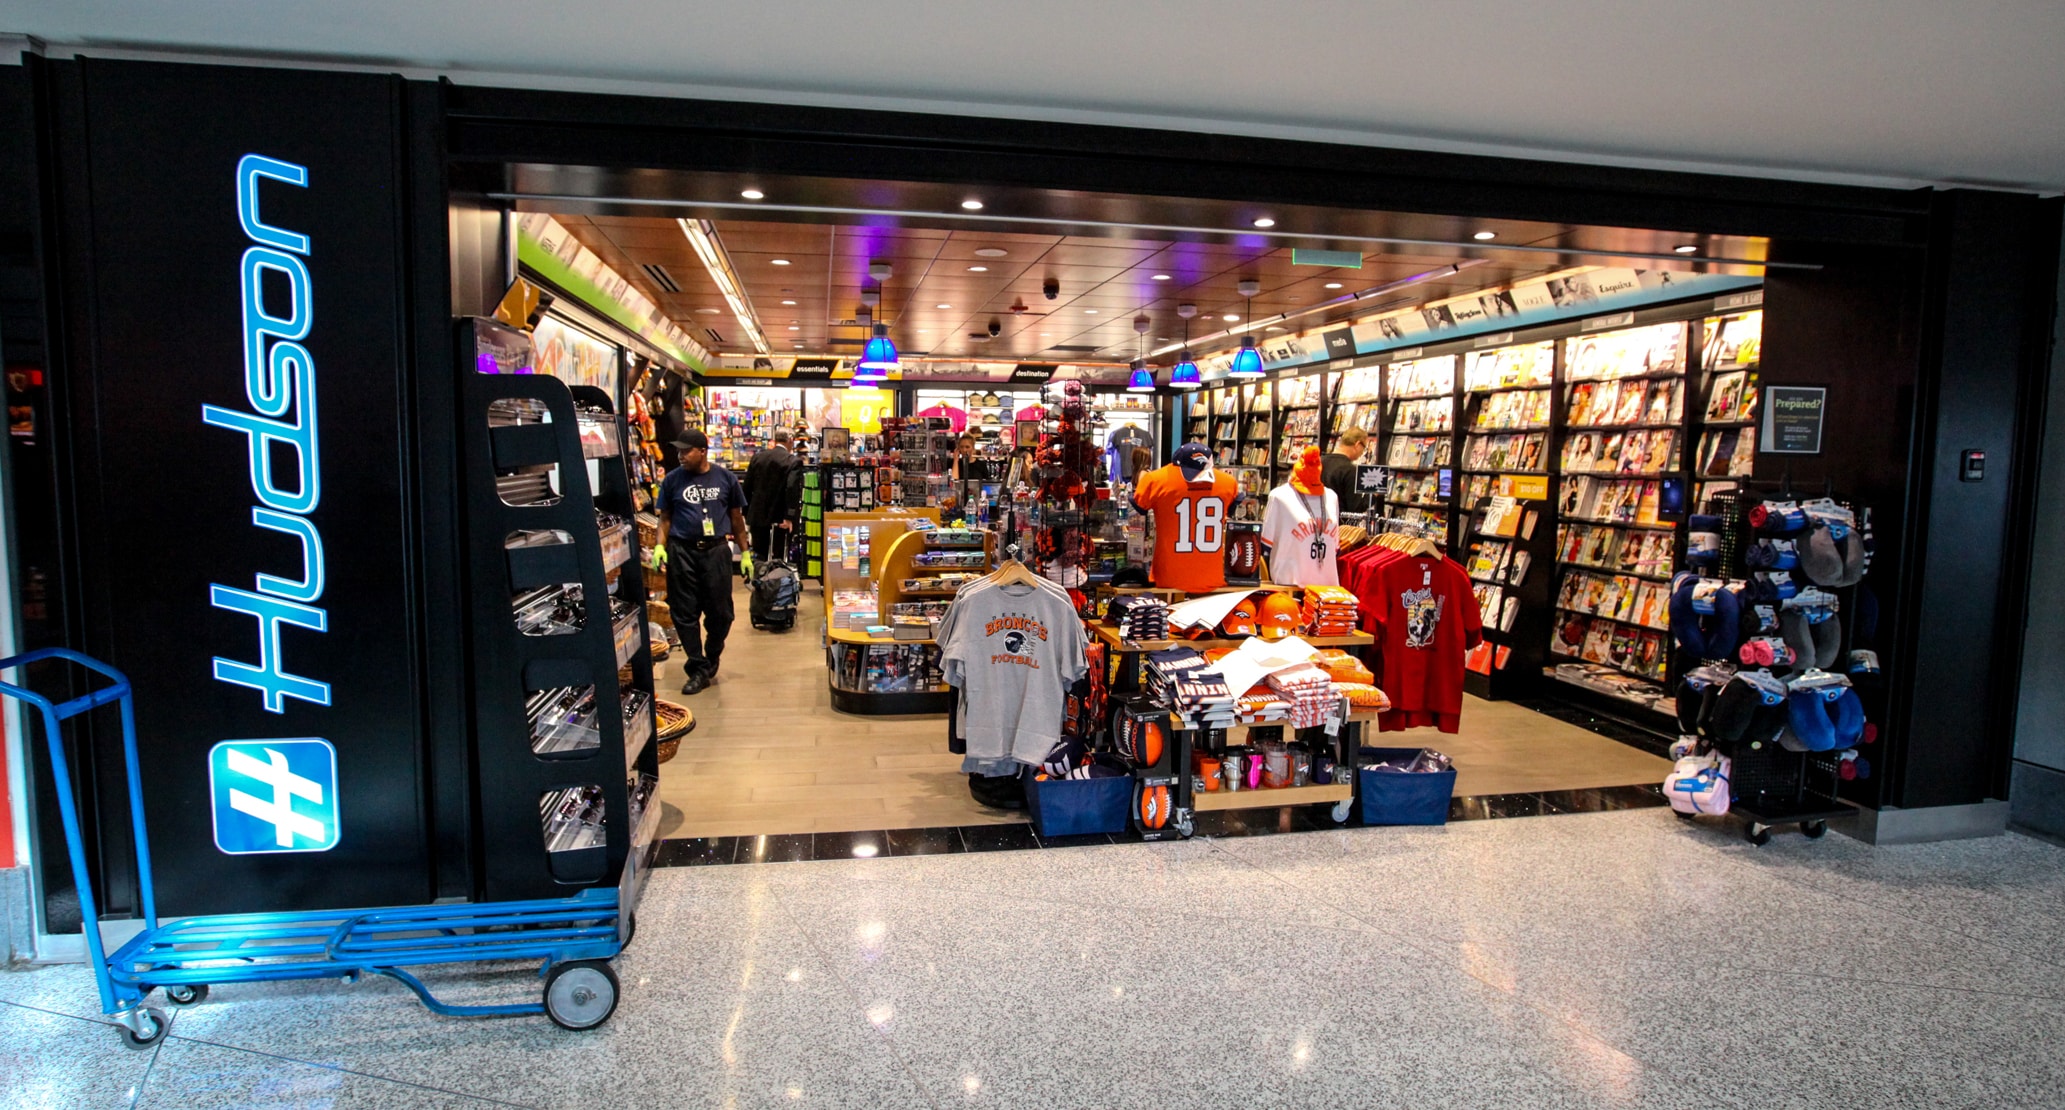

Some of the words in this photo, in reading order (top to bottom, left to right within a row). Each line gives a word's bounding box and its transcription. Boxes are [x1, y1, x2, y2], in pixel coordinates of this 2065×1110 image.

[1599, 281, 1635, 293] Esquire
[796, 365, 829, 373] essentials
[1016, 369, 1049, 378] destination
[1775, 398, 1822, 411] Prepared?
[202, 153, 331, 714] Hudson
[1174, 496, 1224, 553] 18
[992, 612, 1044, 626] DENVER
[985, 616, 1048, 641] BRONCOS
[991, 653, 1040, 669] FOOTBALL
